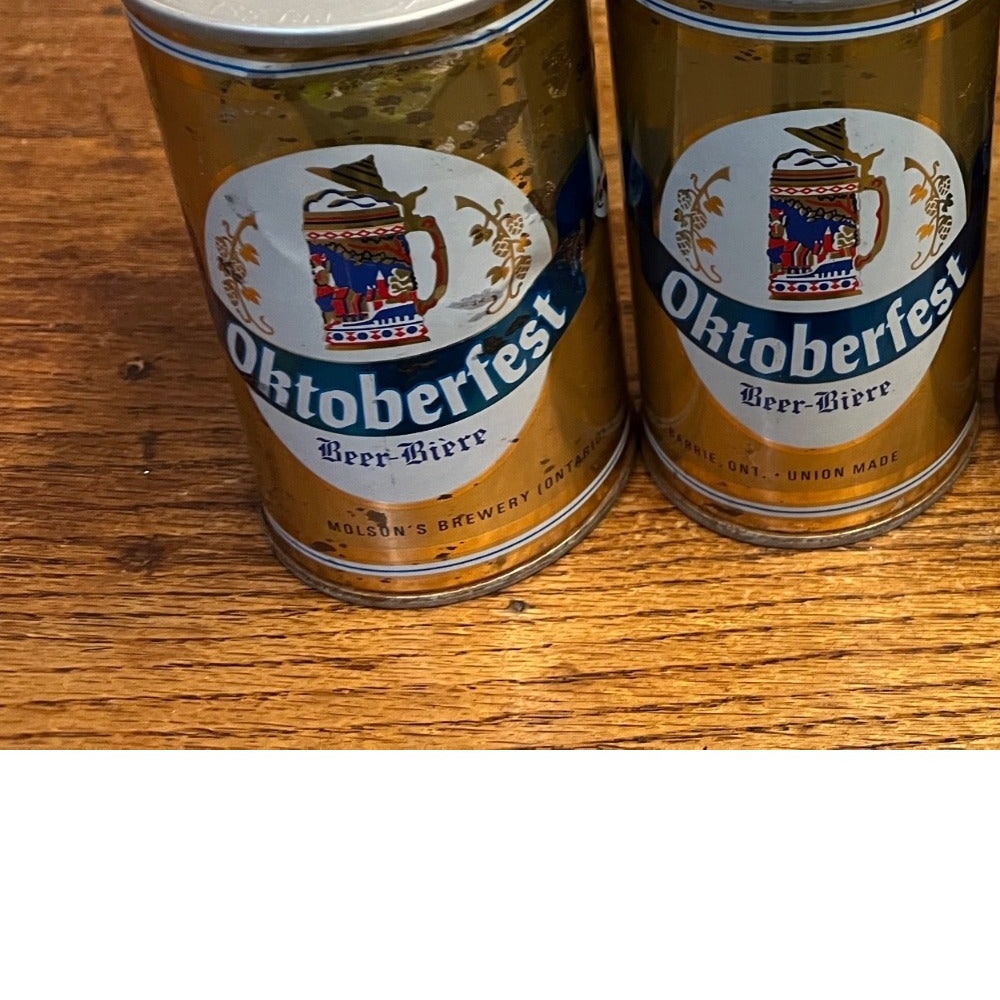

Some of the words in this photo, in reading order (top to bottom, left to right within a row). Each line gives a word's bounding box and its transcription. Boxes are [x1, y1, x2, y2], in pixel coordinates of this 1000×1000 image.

[661, 252, 968, 379] Oktoberfest
[226, 289, 568, 430] Oktoberfest
[787, 466, 845, 482] UNION
[851, 450, 900, 476] MADE
[327, 518, 428, 537] MOLSON'S
[437, 490, 531, 532] BREWERY
